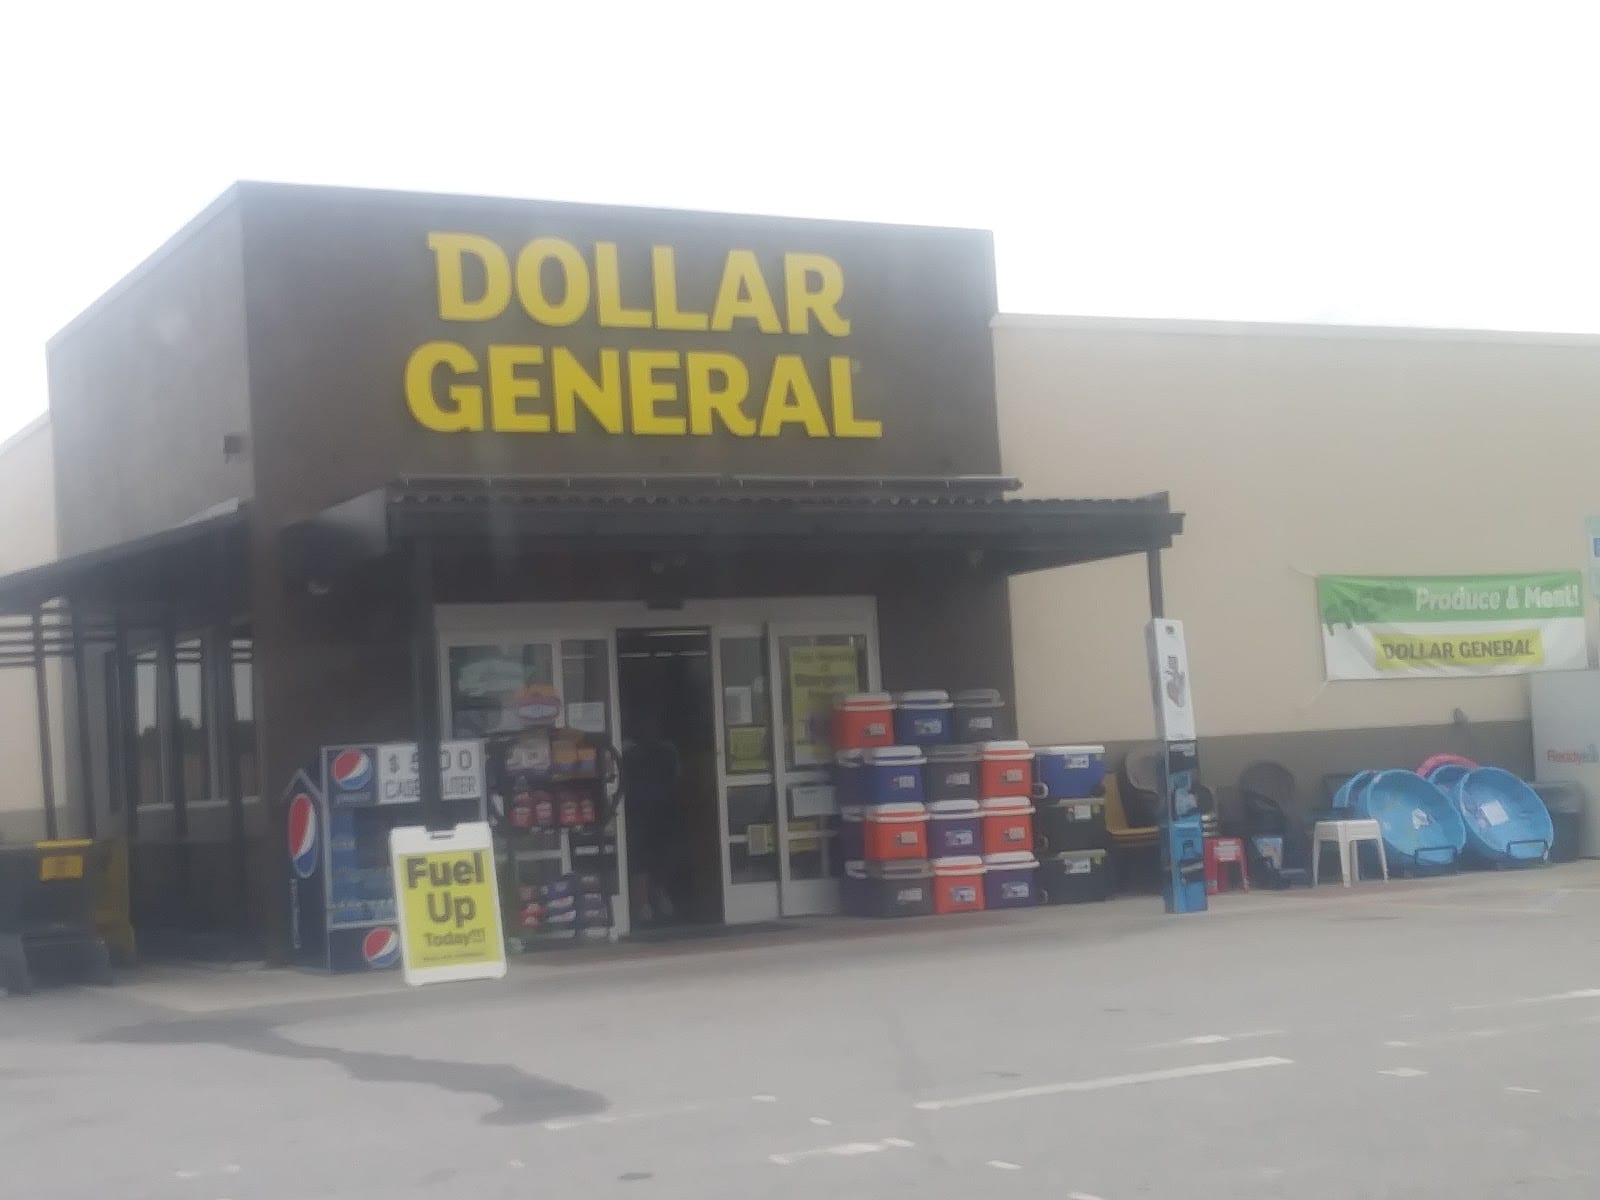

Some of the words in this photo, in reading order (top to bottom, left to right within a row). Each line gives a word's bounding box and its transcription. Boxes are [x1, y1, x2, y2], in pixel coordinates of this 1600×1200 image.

[427, 231, 851, 337] DOLLAR
[404, 340, 883, 439] GENERAL
[1415, 586, 1501, 611] Produce
[1505, 584, 1520, 609] &
[1382, 641, 1455, 661] DOLLAR
[1458, 638, 1536, 658] GENERAL
[406, 851, 486, 889] Fuel
[426, 891, 477, 928] Up
